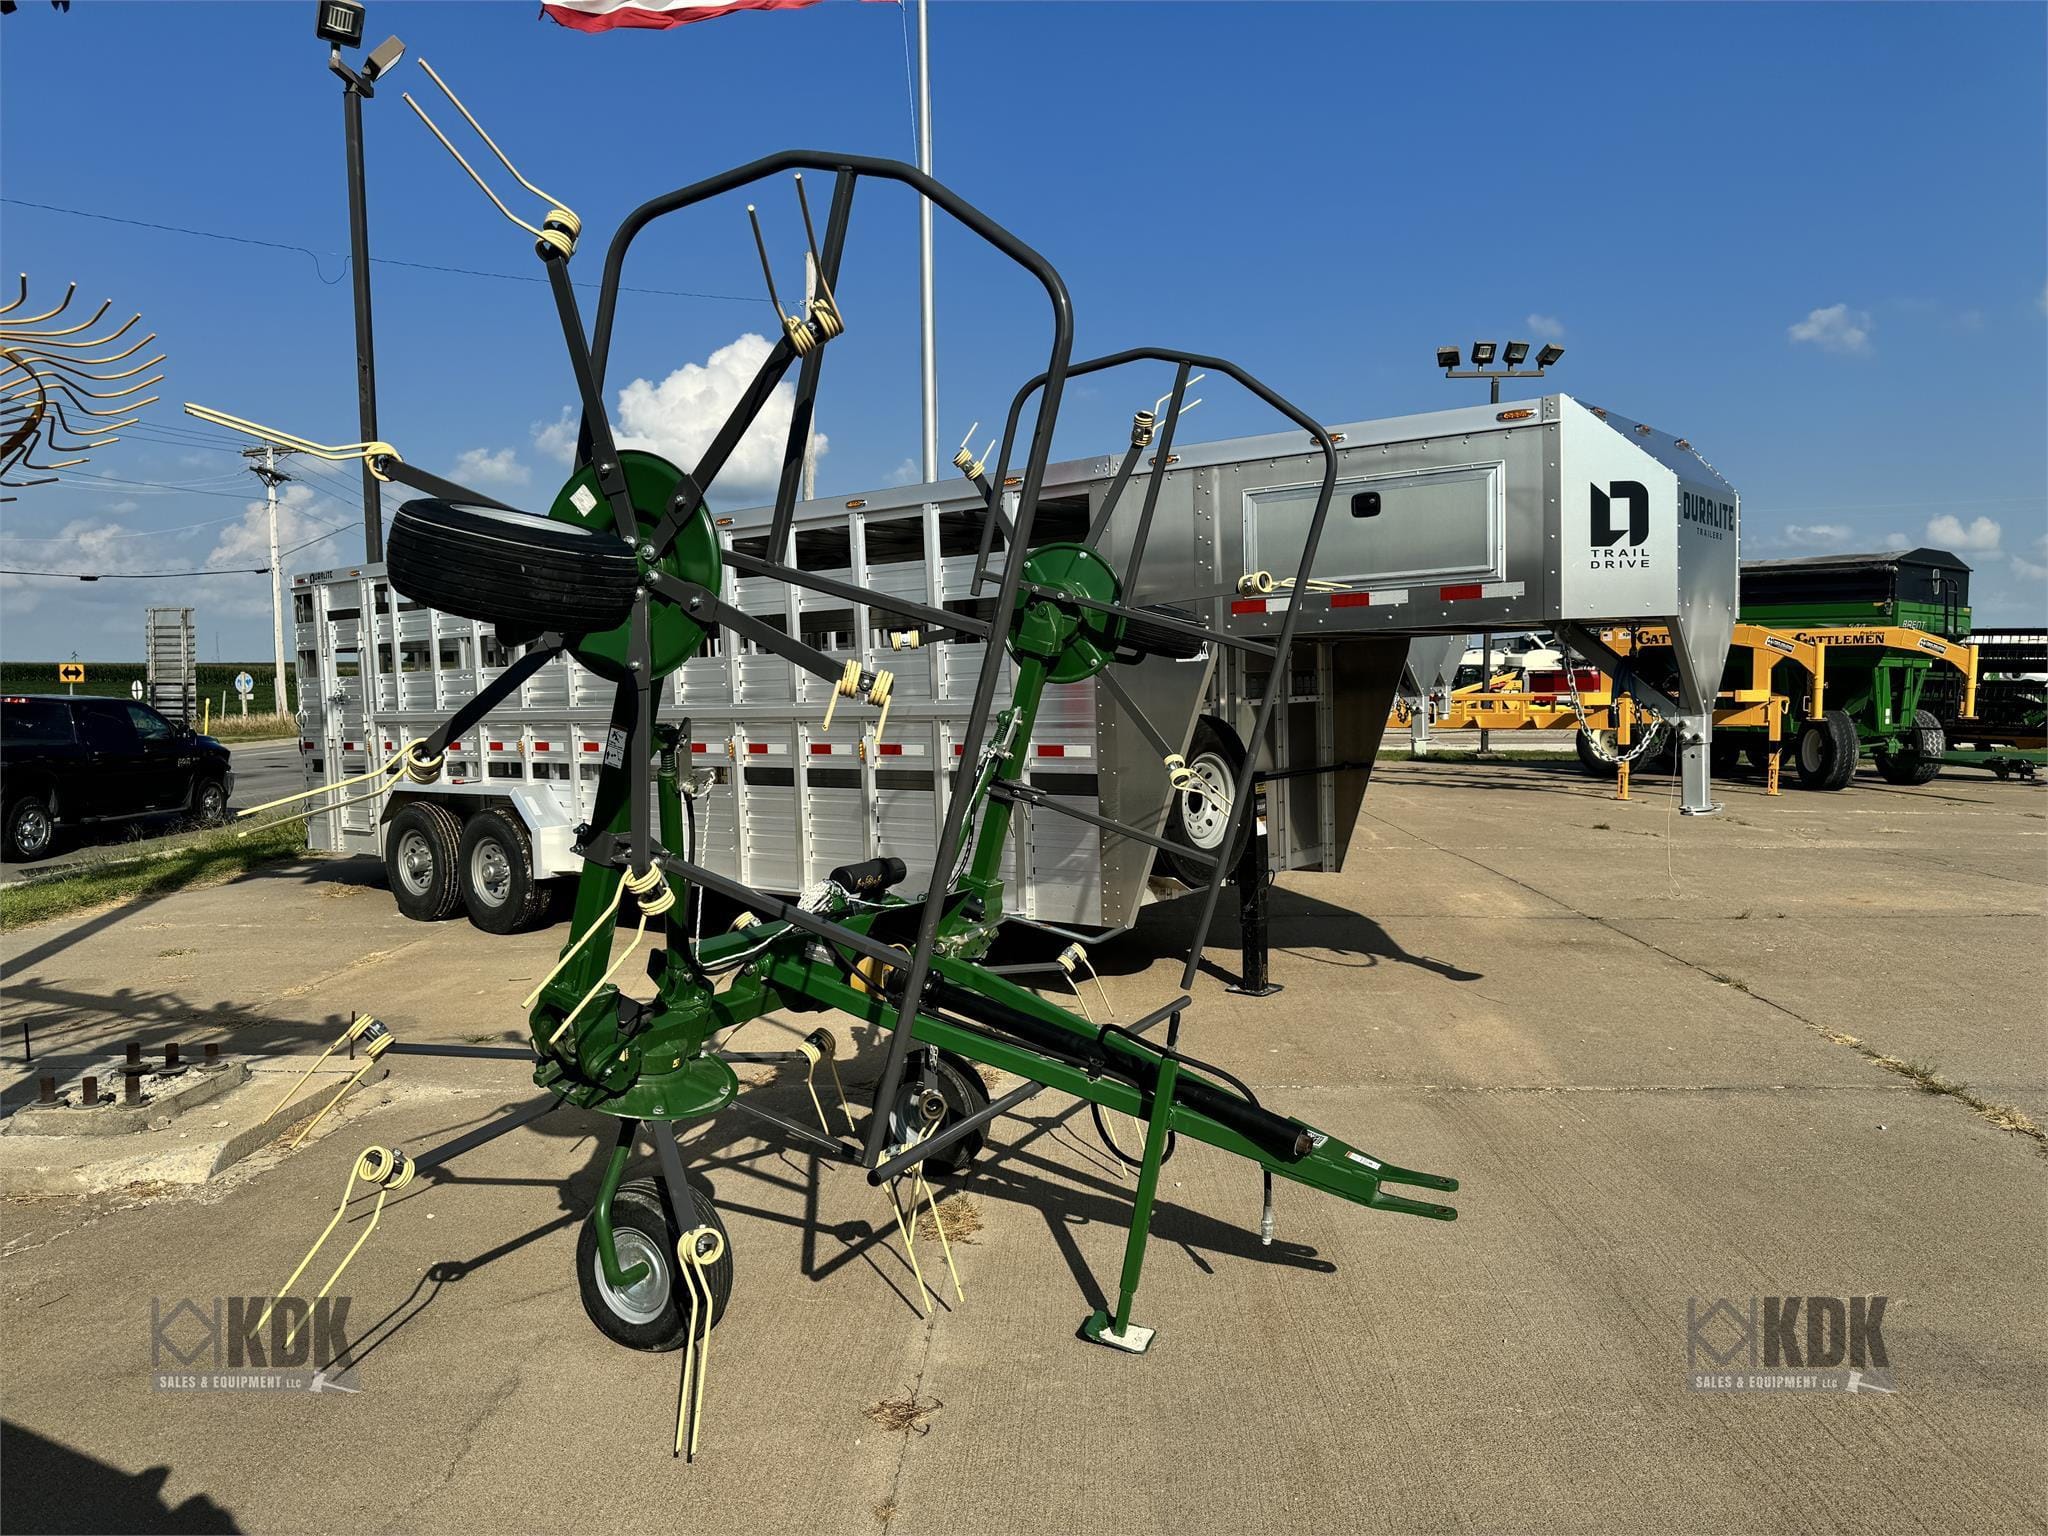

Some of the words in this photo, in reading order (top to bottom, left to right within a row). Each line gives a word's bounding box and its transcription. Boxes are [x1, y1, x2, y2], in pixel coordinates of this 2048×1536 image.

[1683, 491, 1734, 531] DURALITE
[1590, 548, 1650, 558] TRAIL
[1590, 559, 1650, 569] DRIVE
